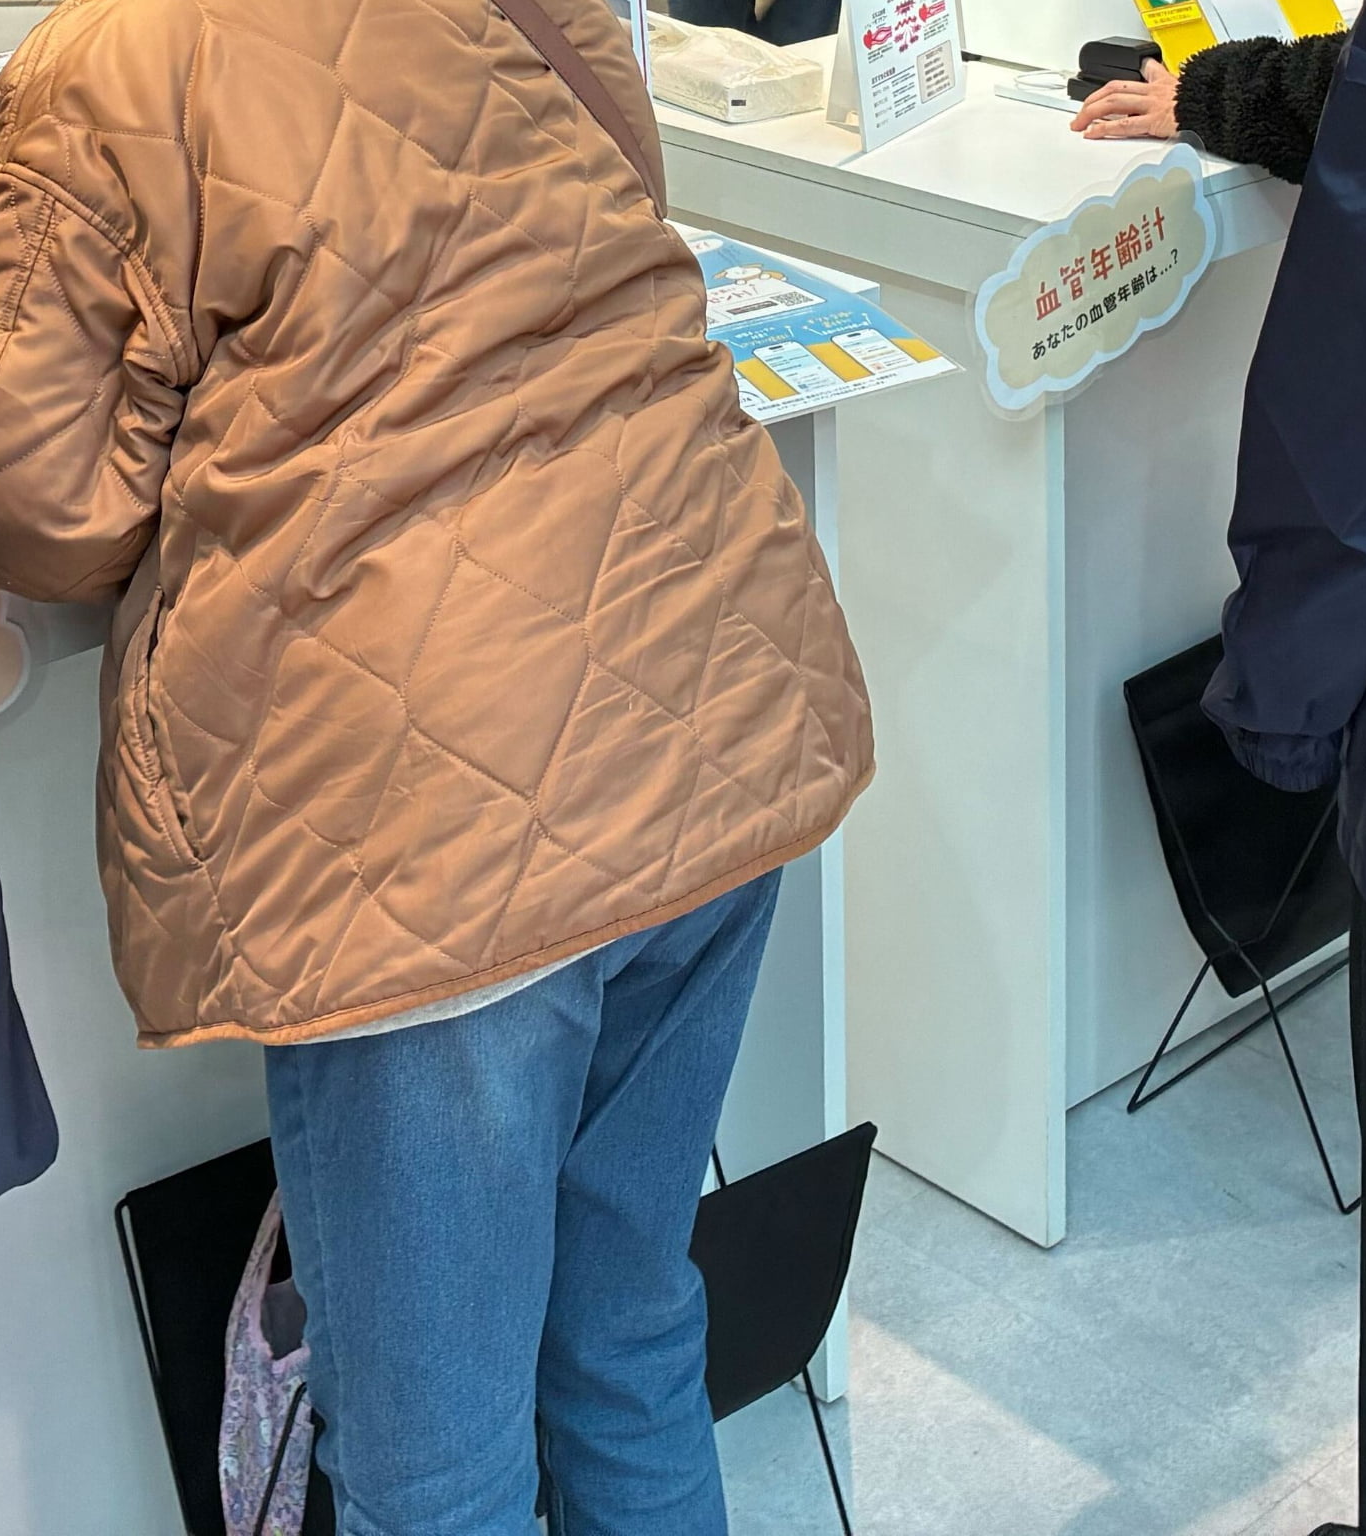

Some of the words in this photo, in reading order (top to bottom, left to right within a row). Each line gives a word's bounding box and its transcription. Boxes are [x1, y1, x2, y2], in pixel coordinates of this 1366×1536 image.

[1035, 206, 1166, 321] 血管年齢計
